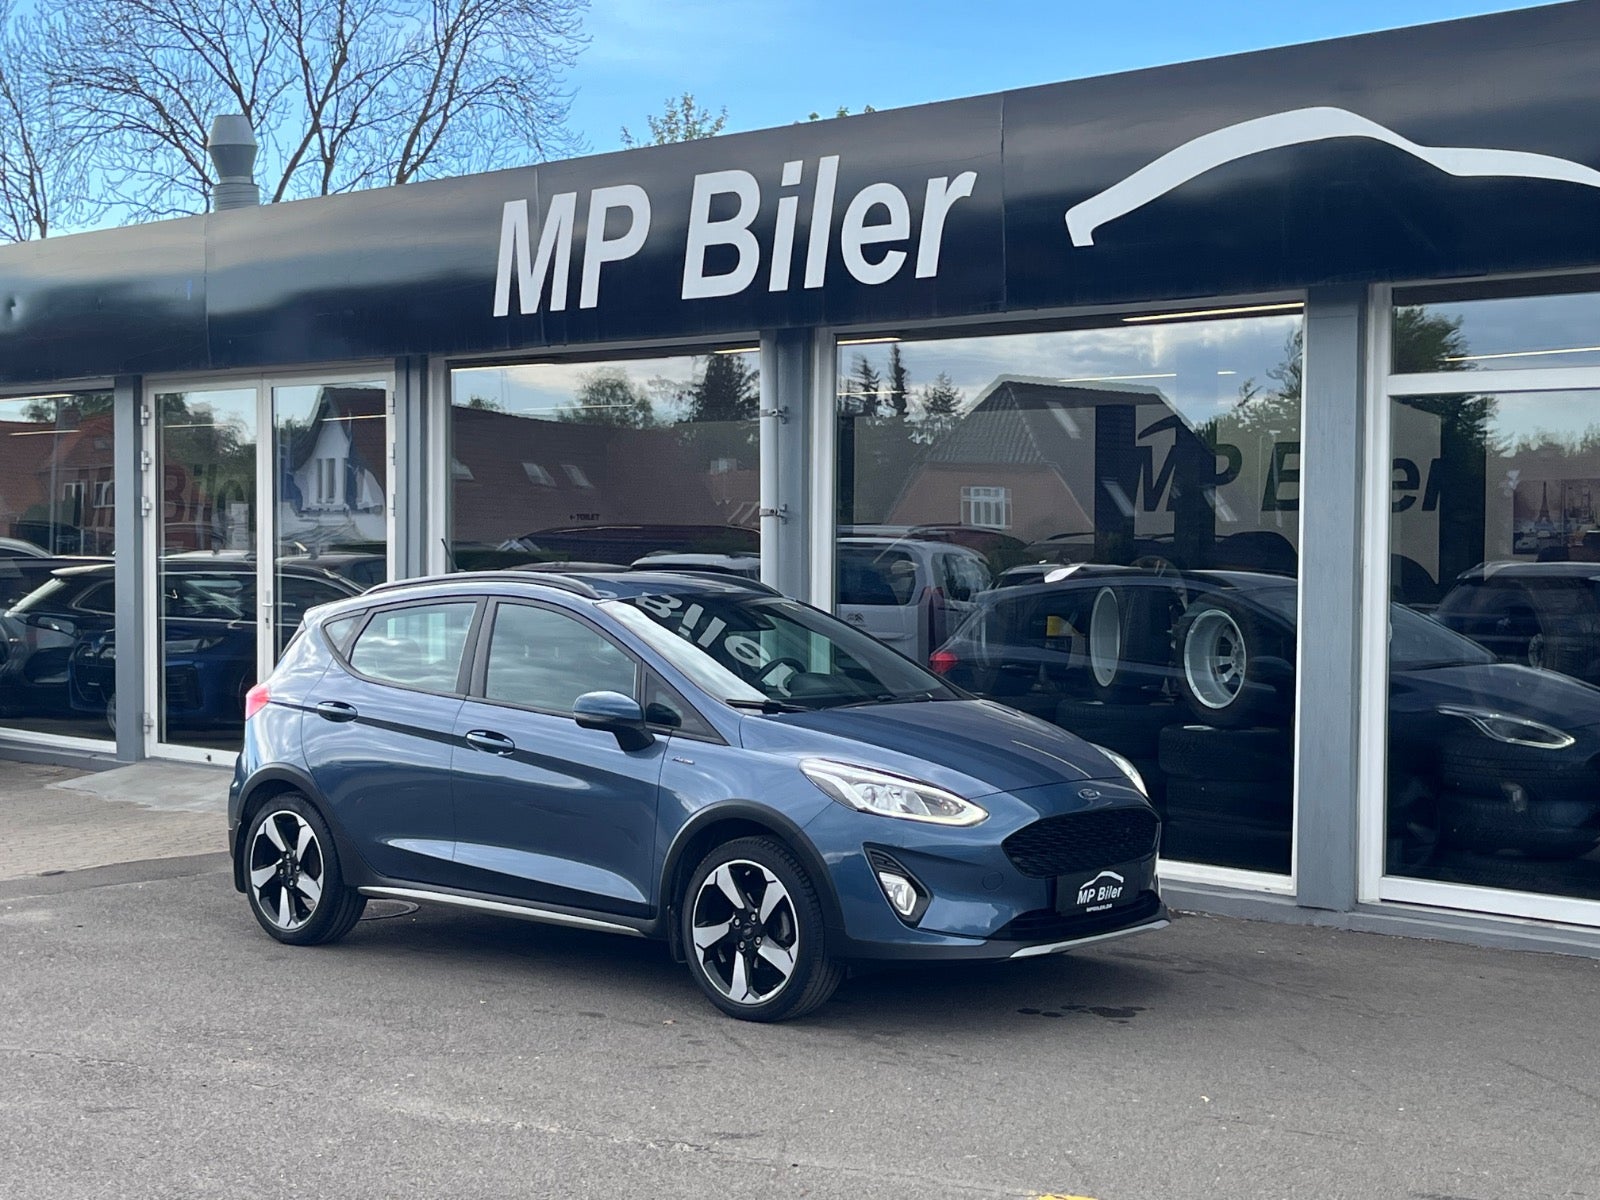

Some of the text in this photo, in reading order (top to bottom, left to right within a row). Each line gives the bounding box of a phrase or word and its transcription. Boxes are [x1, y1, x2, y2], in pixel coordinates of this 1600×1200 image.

[493, 155, 977, 317] MP Biler
[1077, 885, 1123, 905] MP Biler
